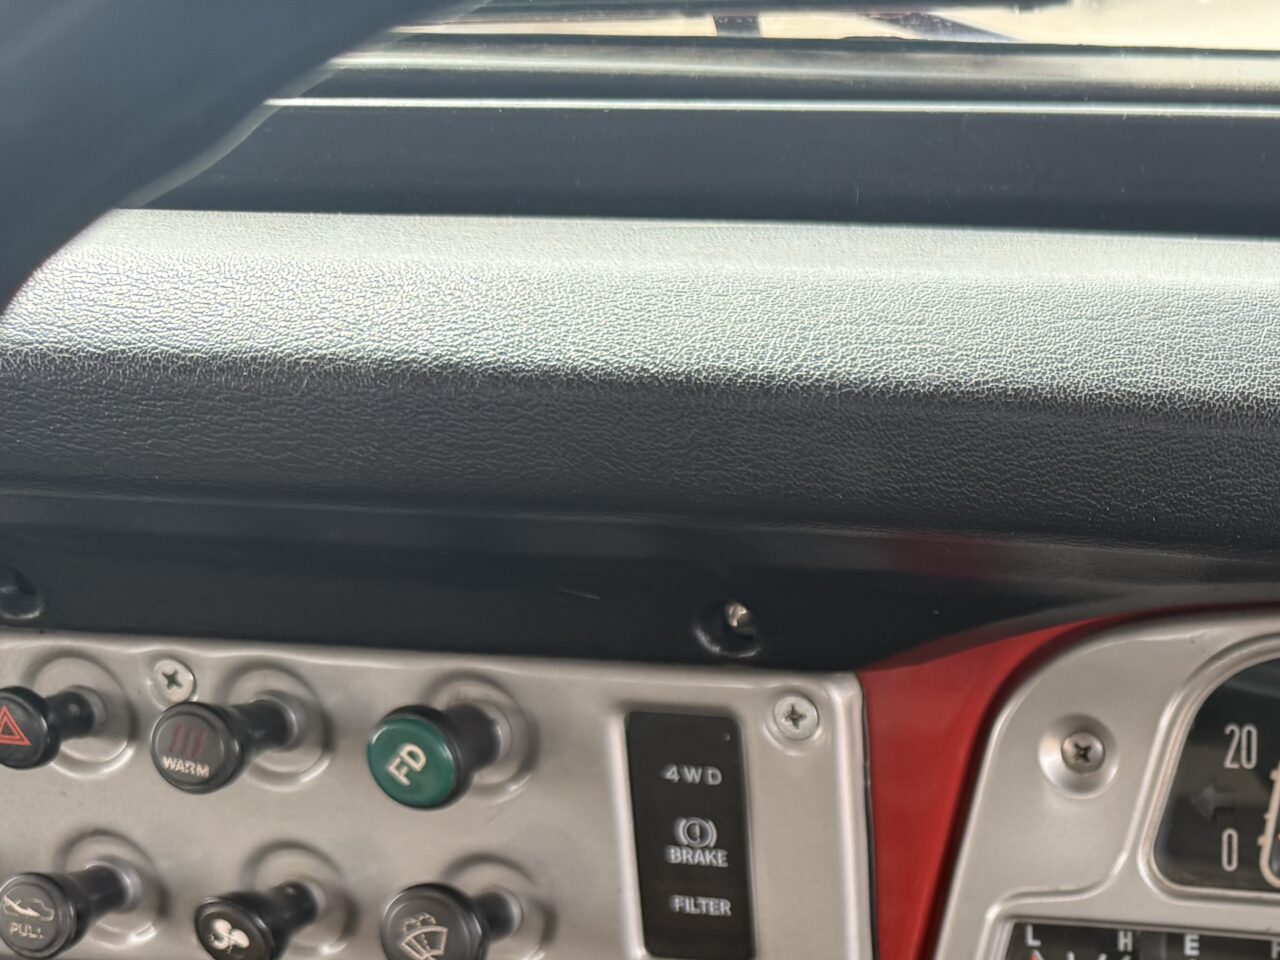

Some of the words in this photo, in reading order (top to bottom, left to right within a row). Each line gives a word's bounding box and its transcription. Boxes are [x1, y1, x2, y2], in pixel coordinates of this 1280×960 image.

[1223, 724, 1258, 769] 20
[163, 756, 210, 779] WARM
[388, 743, 427, 786] FD
[666, 845, 729, 868] BRAKE
[1221, 828, 1239, 872] 0
[671, 895, 733, 917] FILTER
[1025, 924, 1042, 947] L
[1116, 929, 1134, 952] H
[1184, 934, 1200, 957] E
